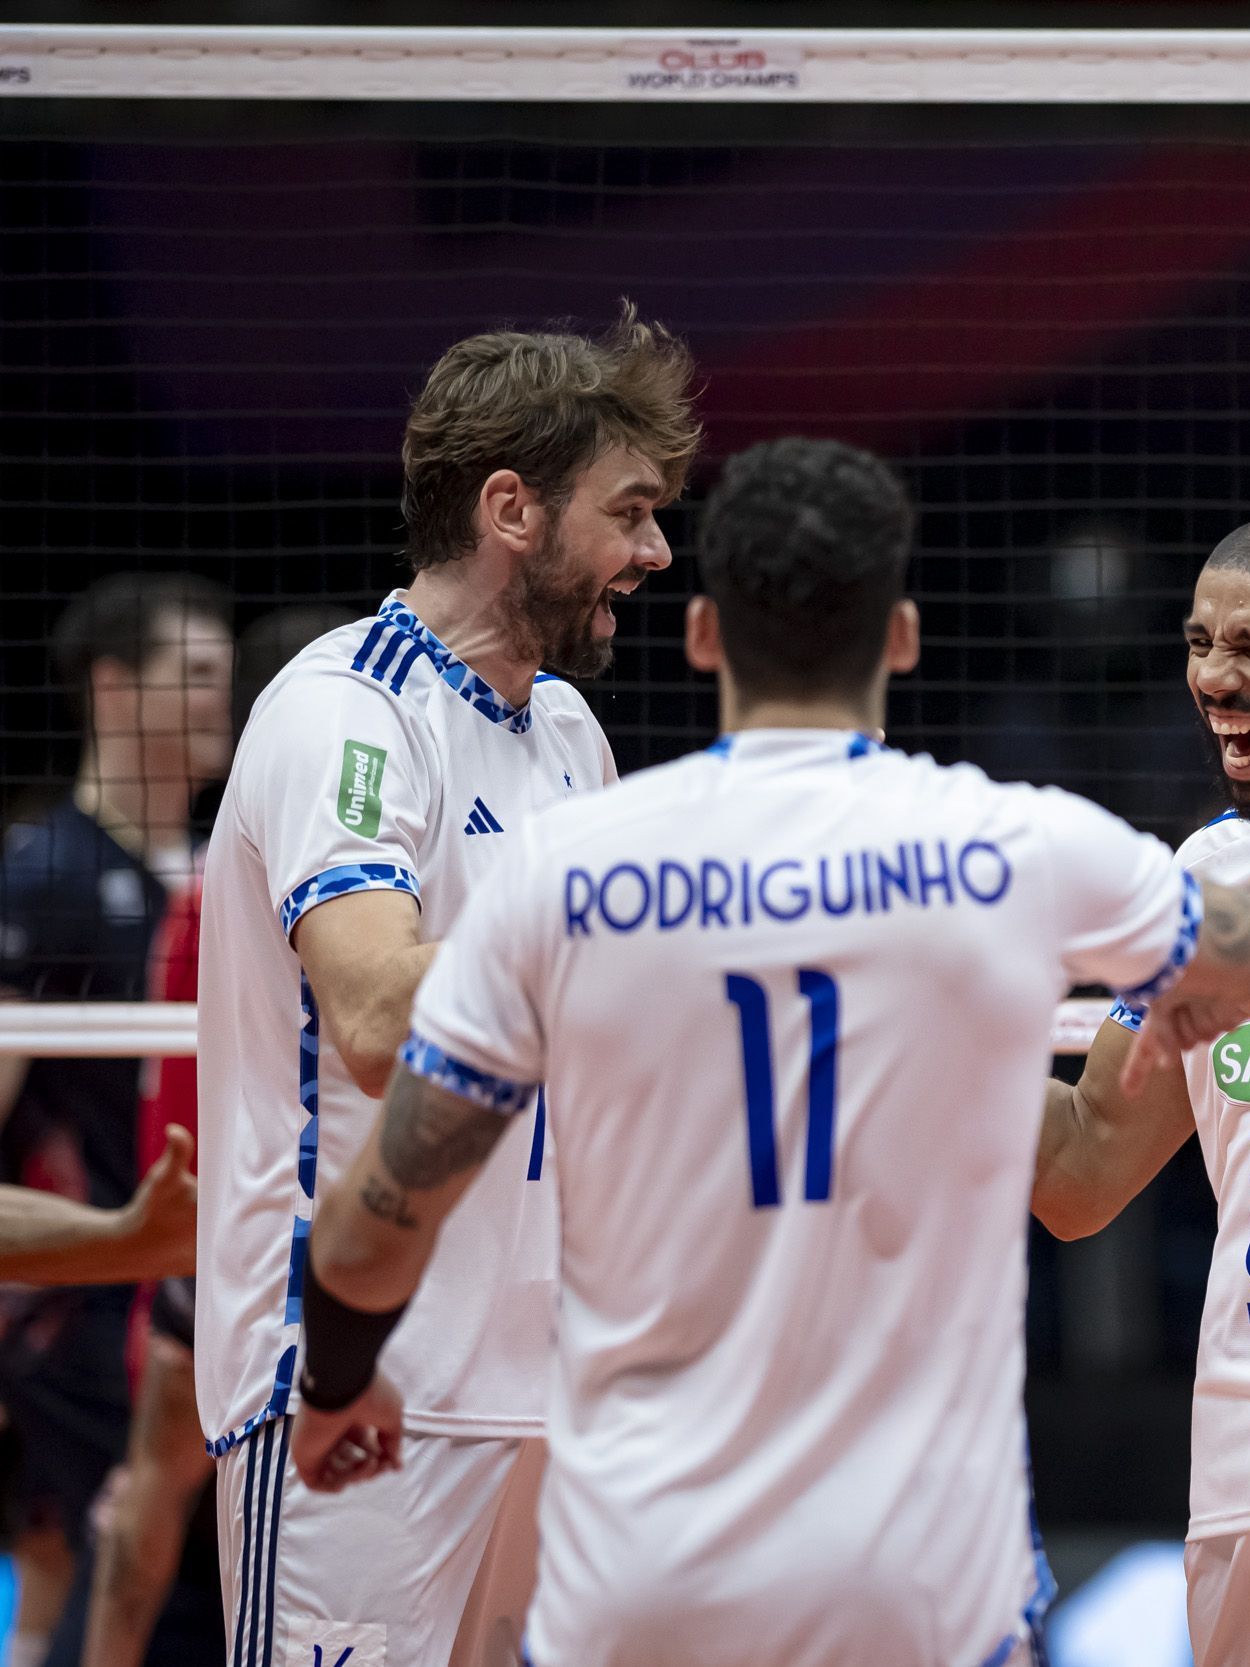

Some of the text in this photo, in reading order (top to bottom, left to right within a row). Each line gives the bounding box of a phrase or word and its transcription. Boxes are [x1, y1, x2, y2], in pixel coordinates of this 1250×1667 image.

[344, 748, 370, 827] Unimed
[564, 839, 1012, 937] RODRIGUINHO
[723, 965, 841, 1211] 11
